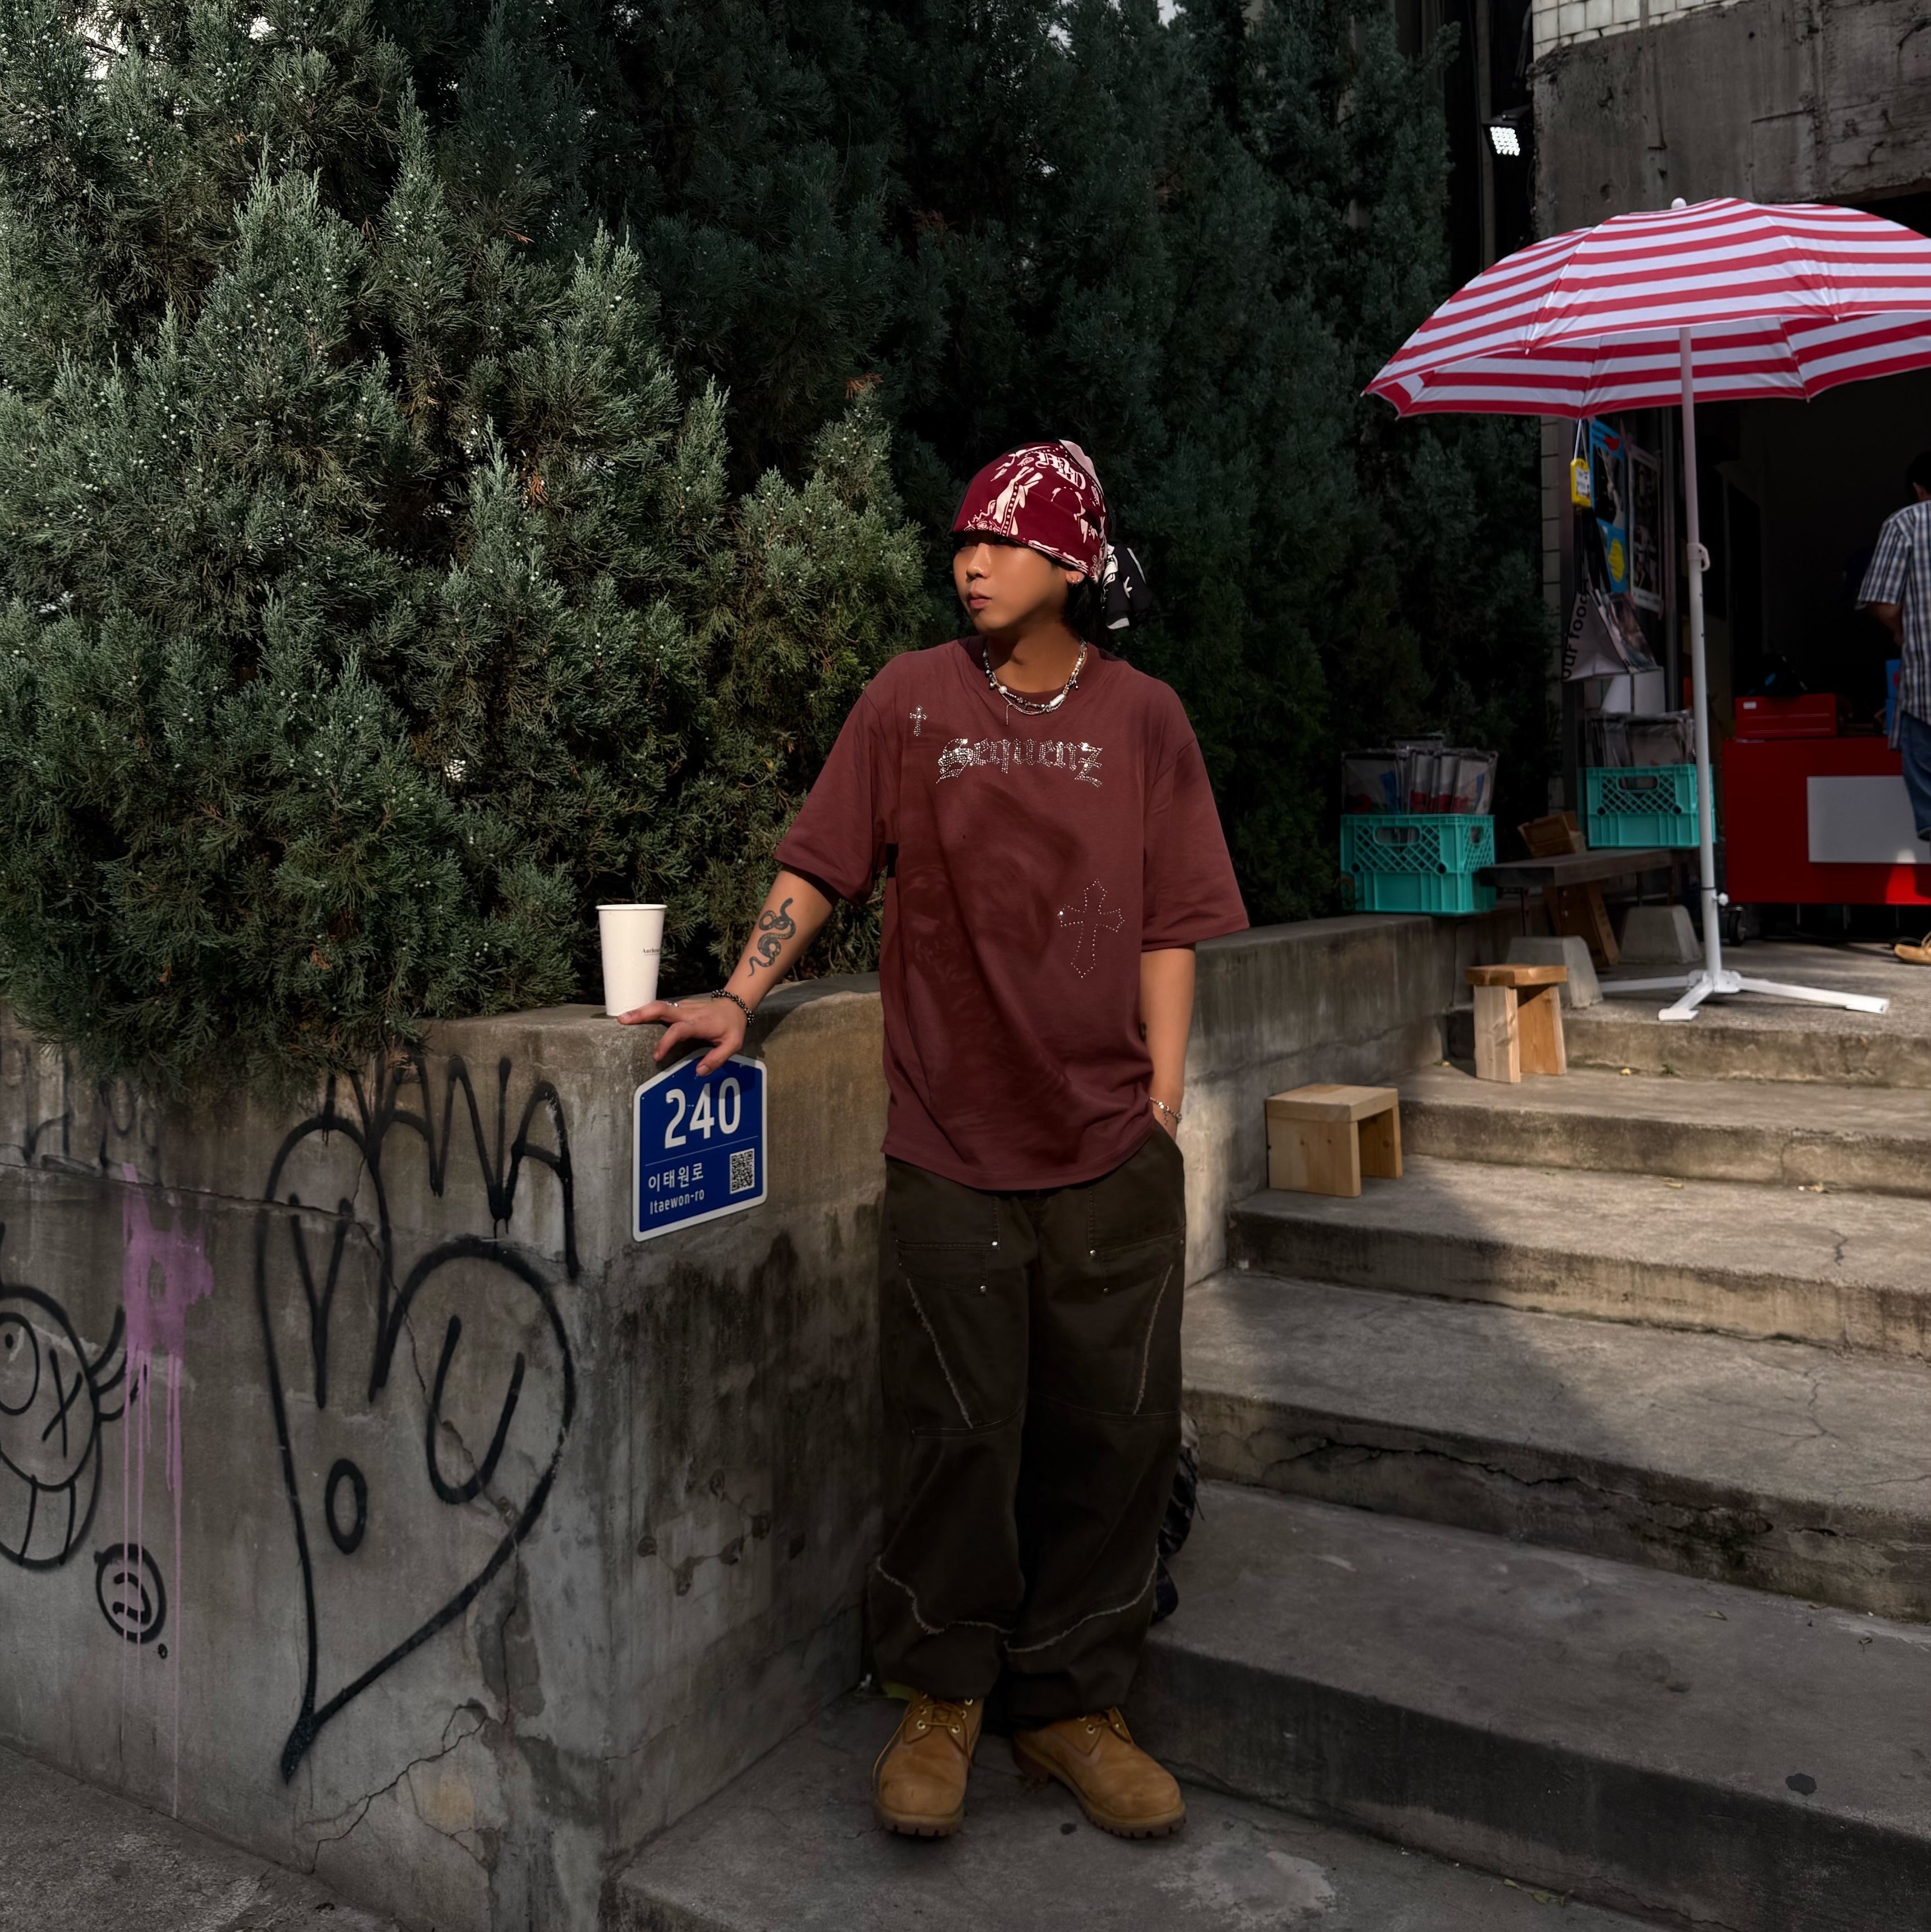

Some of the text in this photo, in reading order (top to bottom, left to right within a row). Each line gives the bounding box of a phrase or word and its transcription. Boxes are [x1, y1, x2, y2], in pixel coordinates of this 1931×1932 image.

[665, 1077, 741, 1149] 240
[648, 1162, 704, 1192] 이태원로
[650, 1189, 705, 1215] Itaewon-ro
